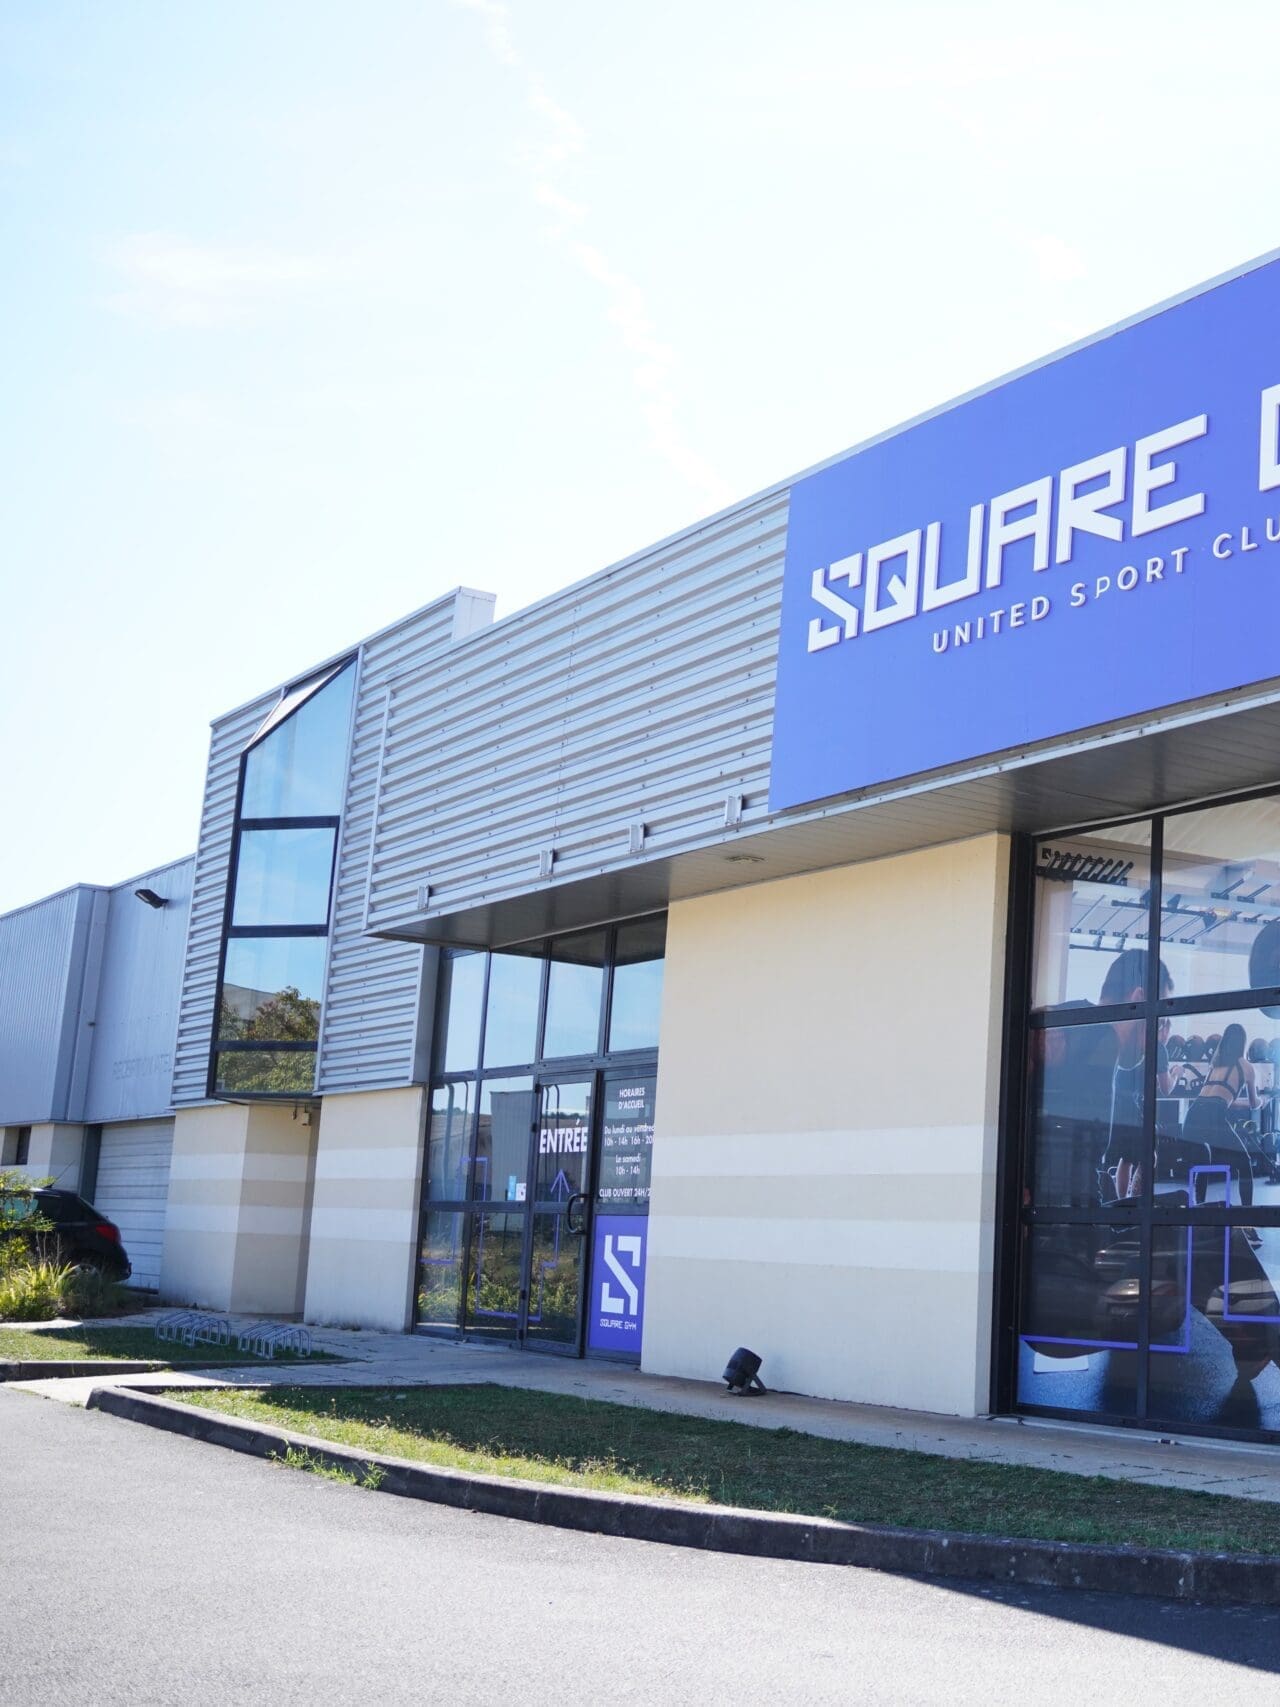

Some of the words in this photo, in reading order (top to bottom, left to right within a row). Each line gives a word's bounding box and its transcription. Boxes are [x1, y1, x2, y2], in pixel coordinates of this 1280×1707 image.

[808, 413, 1208, 653] SQUARE
[932, 596, 1050, 654] UNITED
[1070, 546, 1189, 608] SPORT
[619, 1087, 646, 1098] HORAIRES
[604, 1125, 612, 1134] Du
[539, 1118, 588, 1153] ENTRÉE
[615, 1154, 622, 1163] Le
[622, 1153, 641, 1163] samedi
[599, 1188, 612, 1198] CLUB
[612, 1187, 633, 1198] OUVERT
[599, 1318, 623, 1329] SQUARE
[624, 1321, 637, 1330] GYM
